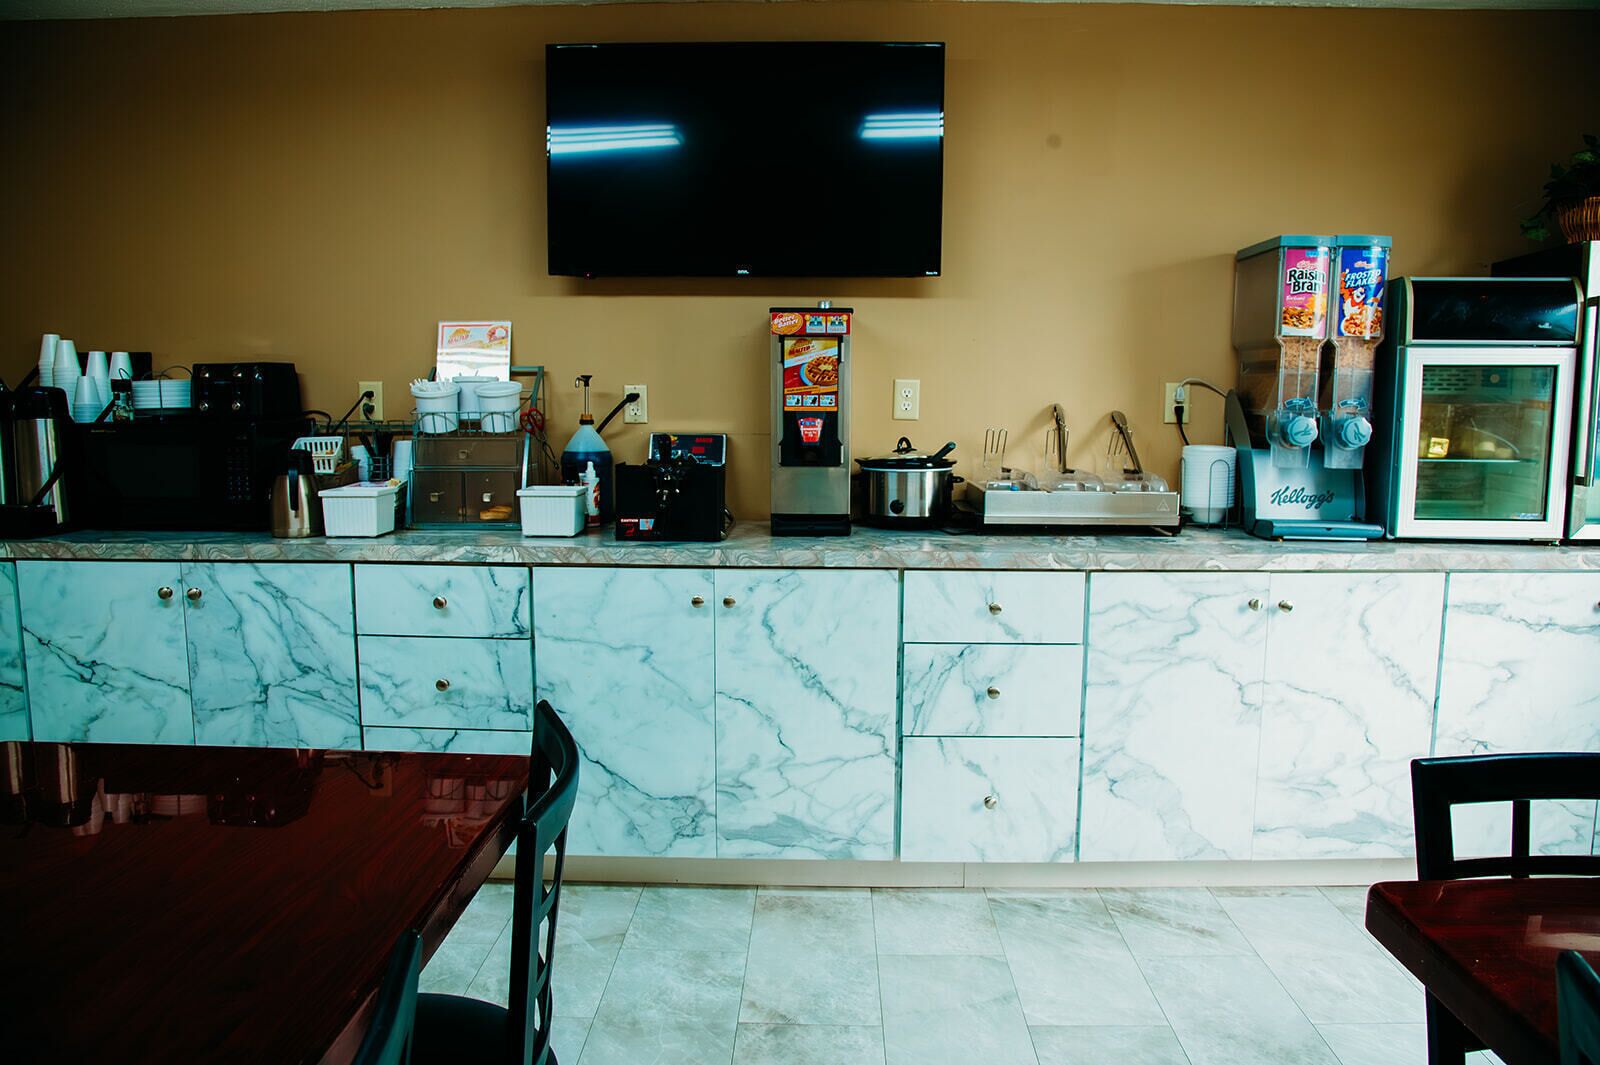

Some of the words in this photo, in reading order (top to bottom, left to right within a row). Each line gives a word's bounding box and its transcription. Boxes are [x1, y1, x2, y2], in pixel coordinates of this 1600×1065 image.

[1287, 268, 1326, 284] Raisin
[1291, 280, 1322, 293] Bran
[1271, 486, 1334, 509] Kellogg's
